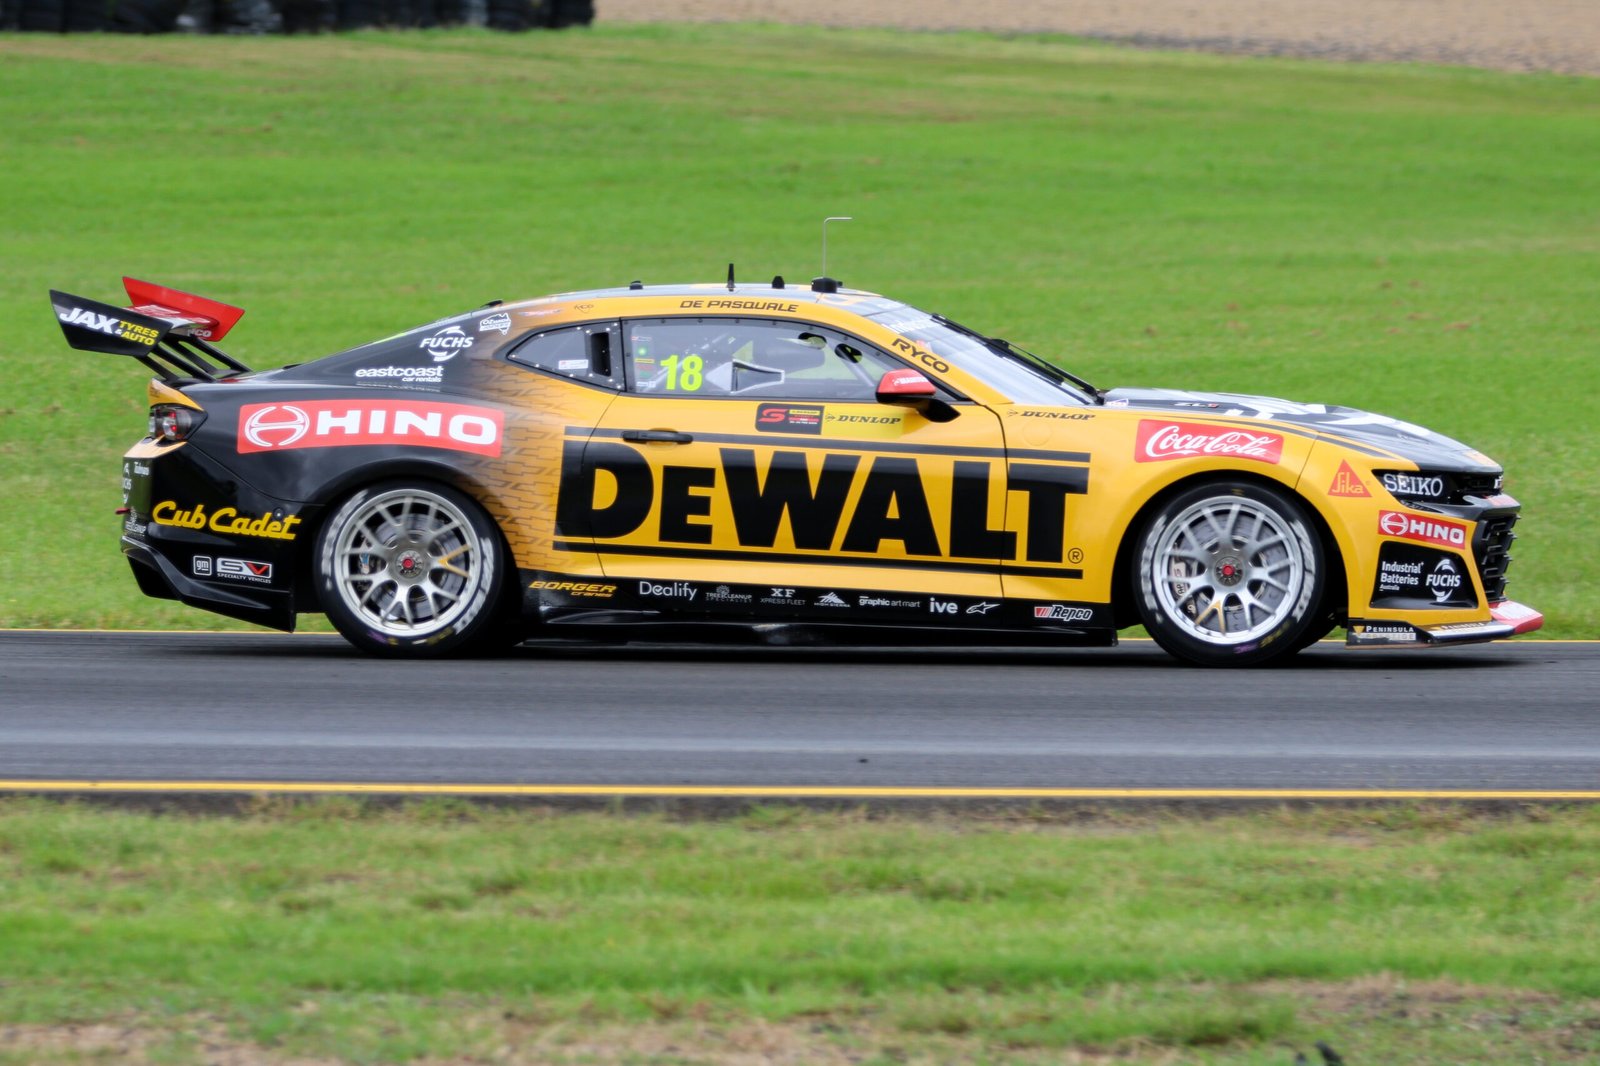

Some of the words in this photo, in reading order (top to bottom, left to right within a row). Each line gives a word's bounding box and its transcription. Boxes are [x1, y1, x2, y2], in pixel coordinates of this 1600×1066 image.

[680, 300, 705, 309] DE
[707, 300, 799, 313] PASQUALE
[59, 307, 120, 334] JAX
[119, 320, 160, 339] TYRES
[121, 331, 156, 346] AUTO
[419, 336, 474, 349] FUCHS
[891, 338, 950, 374] RYCO
[355, 365, 444, 378] eastcoast
[660, 354, 704, 391] 18
[836, 414, 902, 425] DUNLOP
[1020, 410, 1096, 421] DUNLOP
[316, 409, 497, 445] HINO
[1145, 424, 1280, 458] Coca-Cola
[1332, 471, 1364, 494] Sika
[1383, 473, 1444, 497] SEIKO
[152, 500, 207, 530] Cub
[209, 506, 302, 541] Cadet
[1410, 520, 1465, 544] HINO
[1381, 561, 1422, 574] Industrial
[217, 572, 247, 580] SPECIALTY
[248, 576, 272, 584] VEHICLES
[1380, 572, 1419, 586] Batteries
[1425, 573, 1461, 588] FUCHS
[528, 580, 618, 593] BORGER
[639, 581, 698, 600] Dealify
[771, 588, 796, 598] XF
[859, 596, 890, 608] graphic
[902, 600, 920, 608] mart
[930, 598, 958, 614] ive
[1050, 605, 1093, 621] Repco
[1366, 625, 1414, 633] PENINSULA
